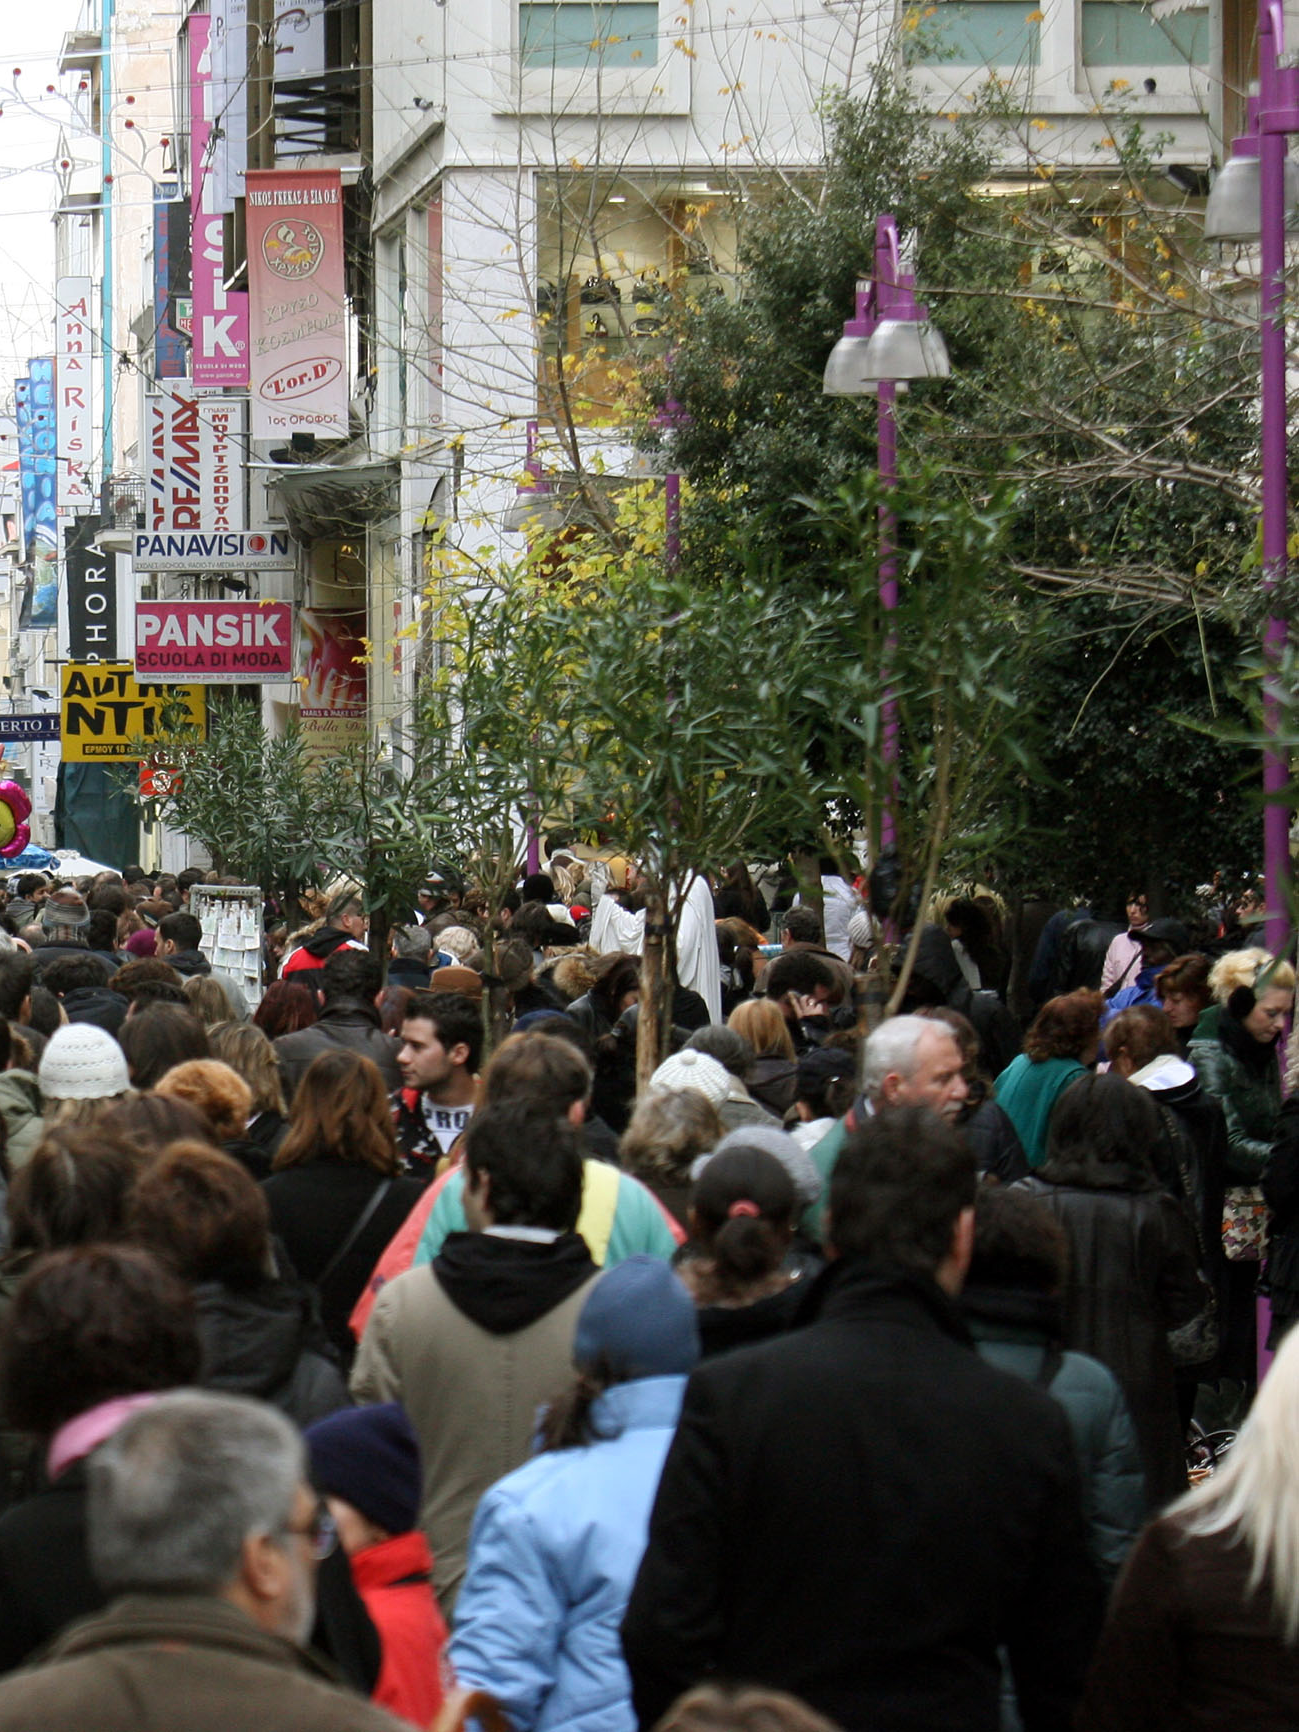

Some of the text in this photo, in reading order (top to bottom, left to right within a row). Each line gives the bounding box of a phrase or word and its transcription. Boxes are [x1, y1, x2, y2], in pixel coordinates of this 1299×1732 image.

[249, 191, 272, 206] ΝΙΚΟΣ
[170, 391, 200, 530] RE/MAX
[136, 533, 289, 557] PANAVISION
[137, 613, 282, 647] PANSiK
[137, 652, 283, 667] SCUOLA DI MODA
[85, 745, 114, 754] ΕΡΜΟΥ
[115, 744, 126, 754] 18
